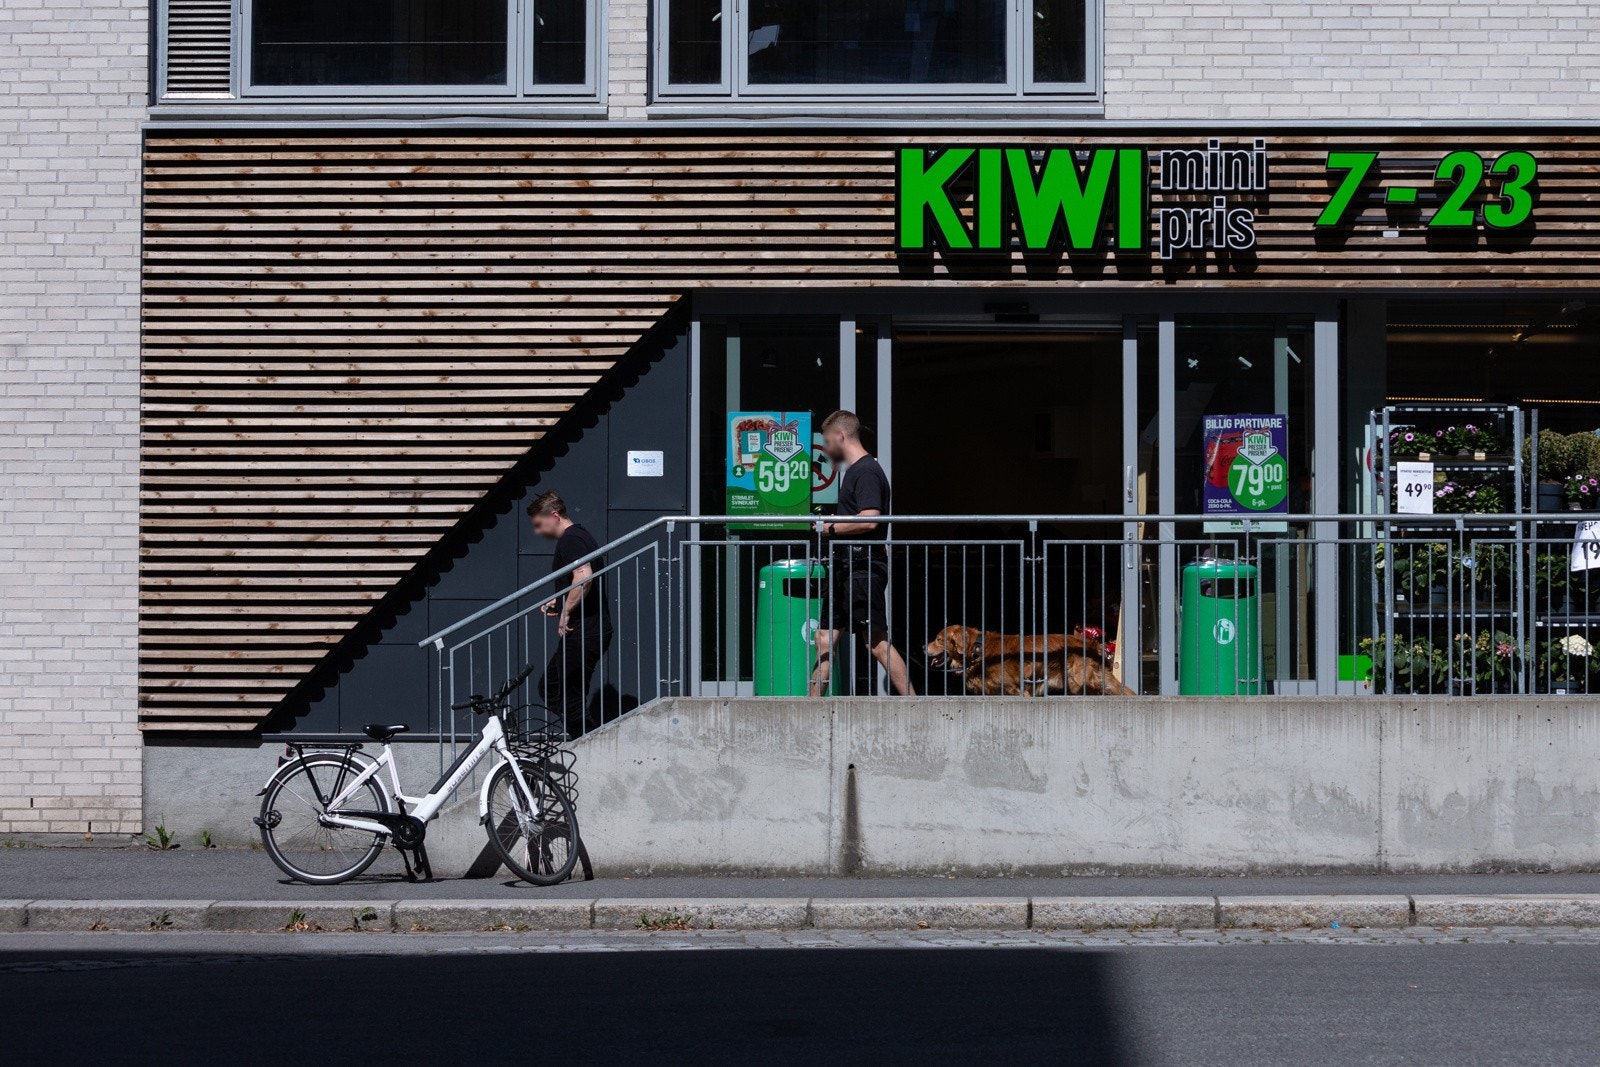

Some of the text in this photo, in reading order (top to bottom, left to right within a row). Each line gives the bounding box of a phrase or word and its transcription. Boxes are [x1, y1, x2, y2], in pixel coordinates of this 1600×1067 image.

[1160, 136, 1267, 191] mini
[1313, 149, 1380, 229] 7
[1425, 148, 1540, 230] 23
[897, 145, 1147, 252] KIWI
[1160, 196, 1256, 260] pris
[774, 432, 794, 441] KIWI
[1206, 418, 1282, 428] BILLIG PARTIVARE
